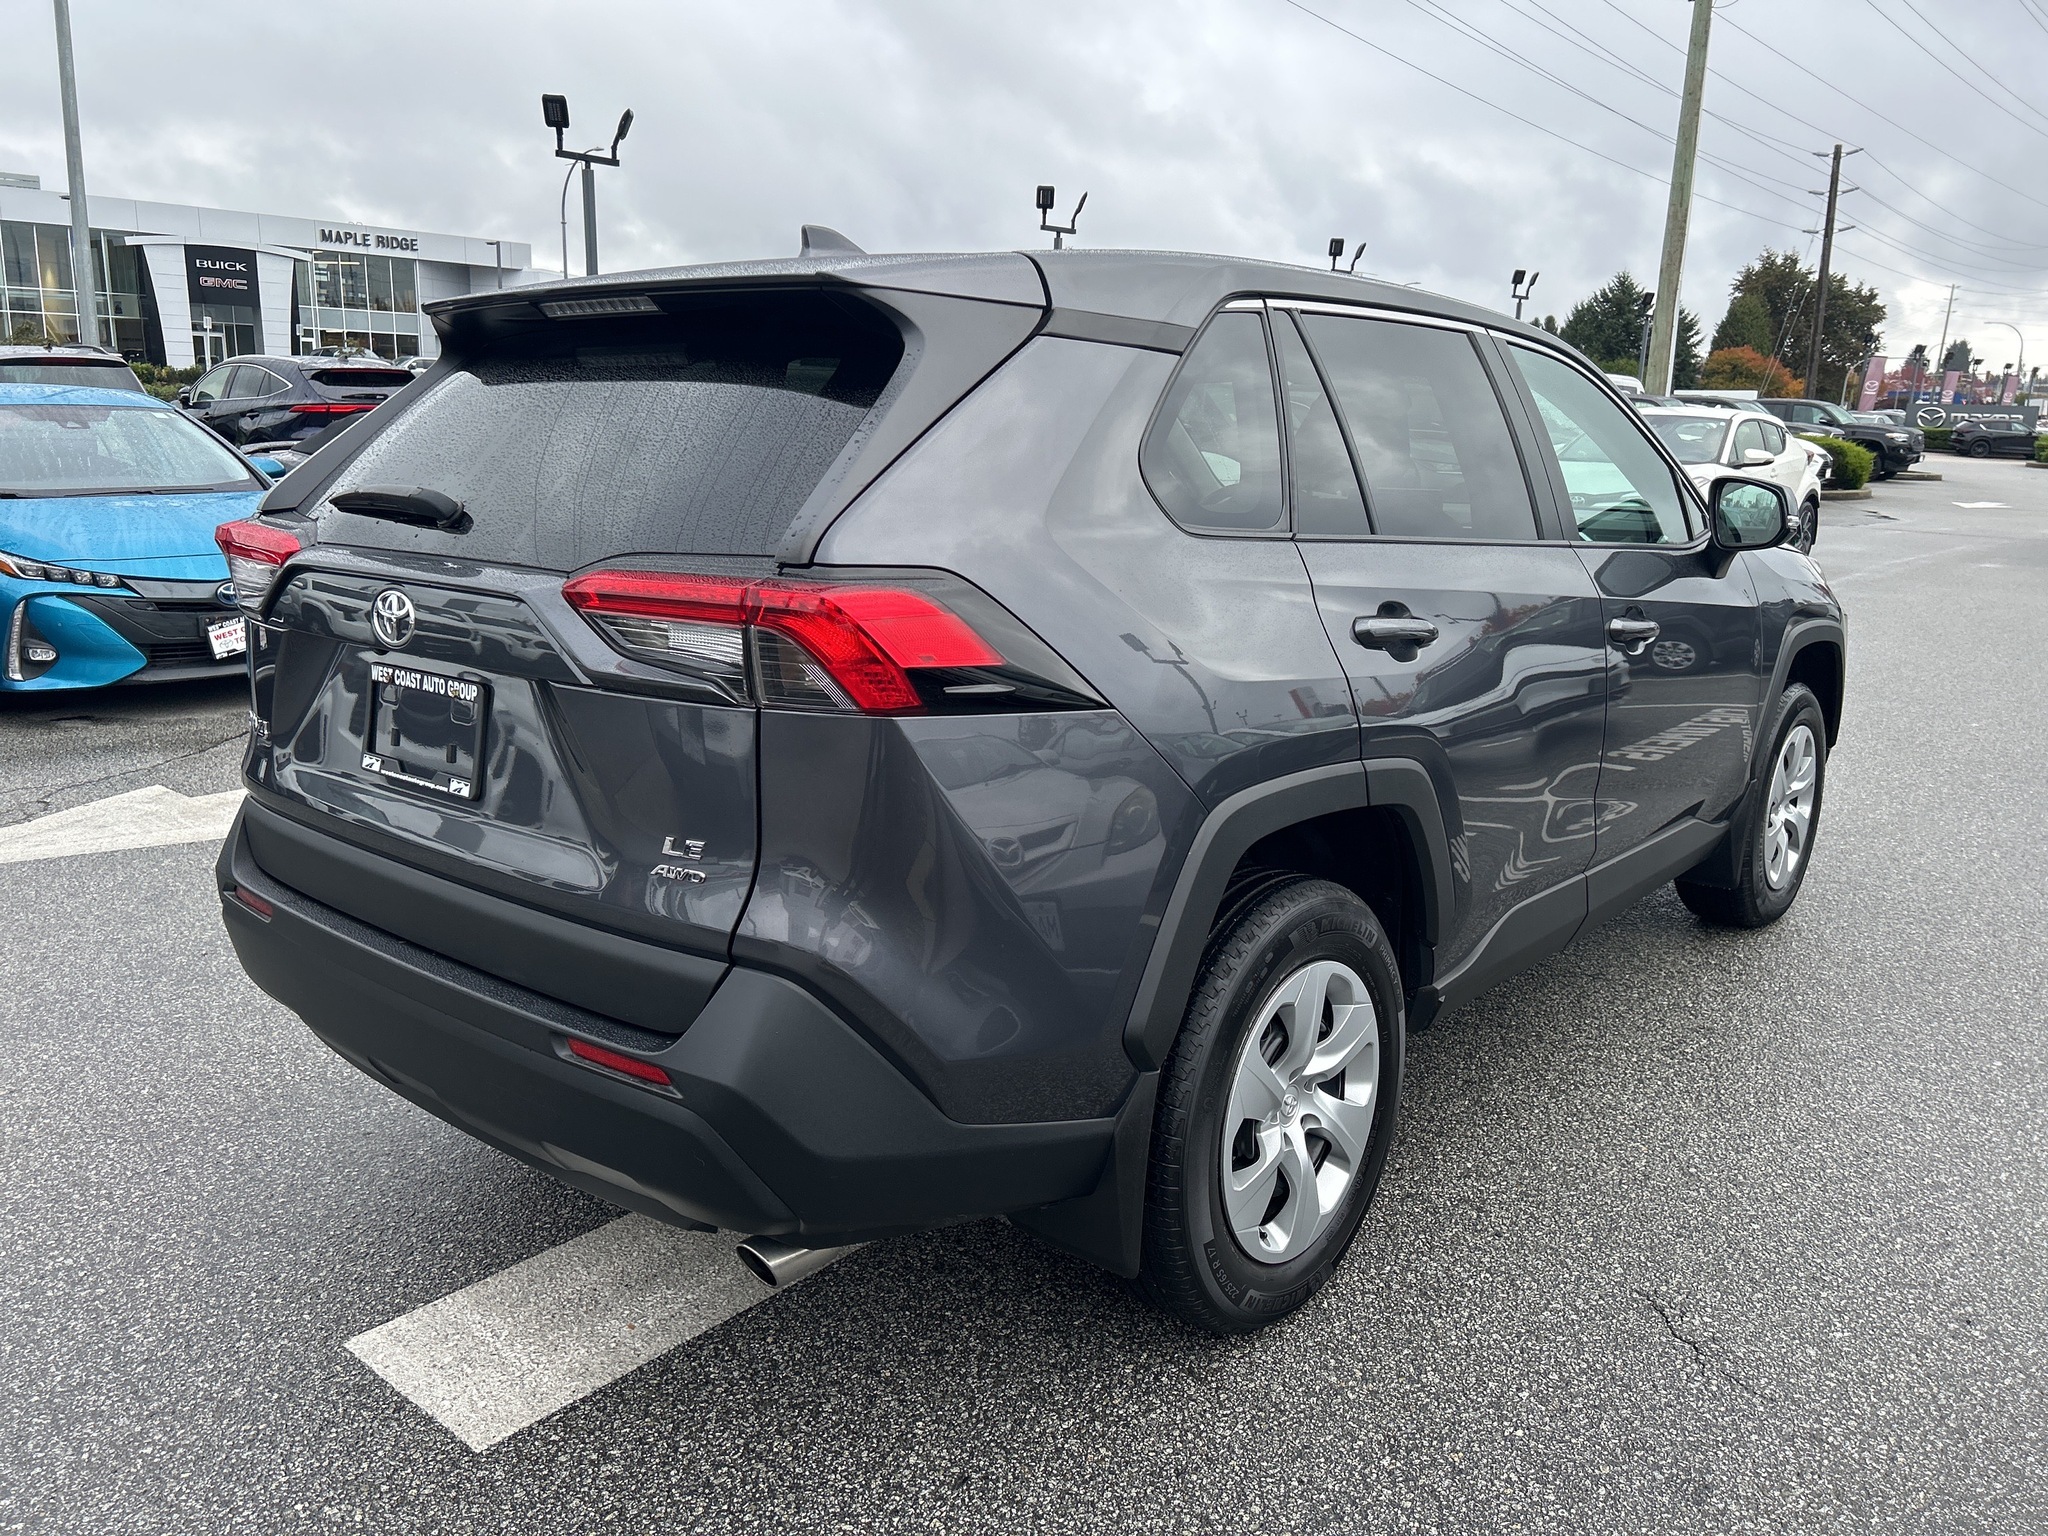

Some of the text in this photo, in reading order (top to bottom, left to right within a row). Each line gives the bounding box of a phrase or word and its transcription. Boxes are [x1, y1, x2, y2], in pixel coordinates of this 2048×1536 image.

[320, 228, 419, 251] MAPLE RIDGE
[195, 258, 248, 272] BUICK
[199, 275, 248, 290] GMC
[213, 628, 239, 641] WEST
[394, 669, 421, 690] COAST
[422, 675, 446, 695] AUTO
[447, 680, 478, 702] GROUP
[661, 836, 707, 860] LE
[649, 864, 706, 883] AWD
[1320, 917, 1376, 944] MICHELIN
[1379, 944, 1399, 985] PRIMACY
[1207, 1247, 1240, 1299] 225/65 R 17
[1244, 1286, 1309, 1310] MICHELIN
